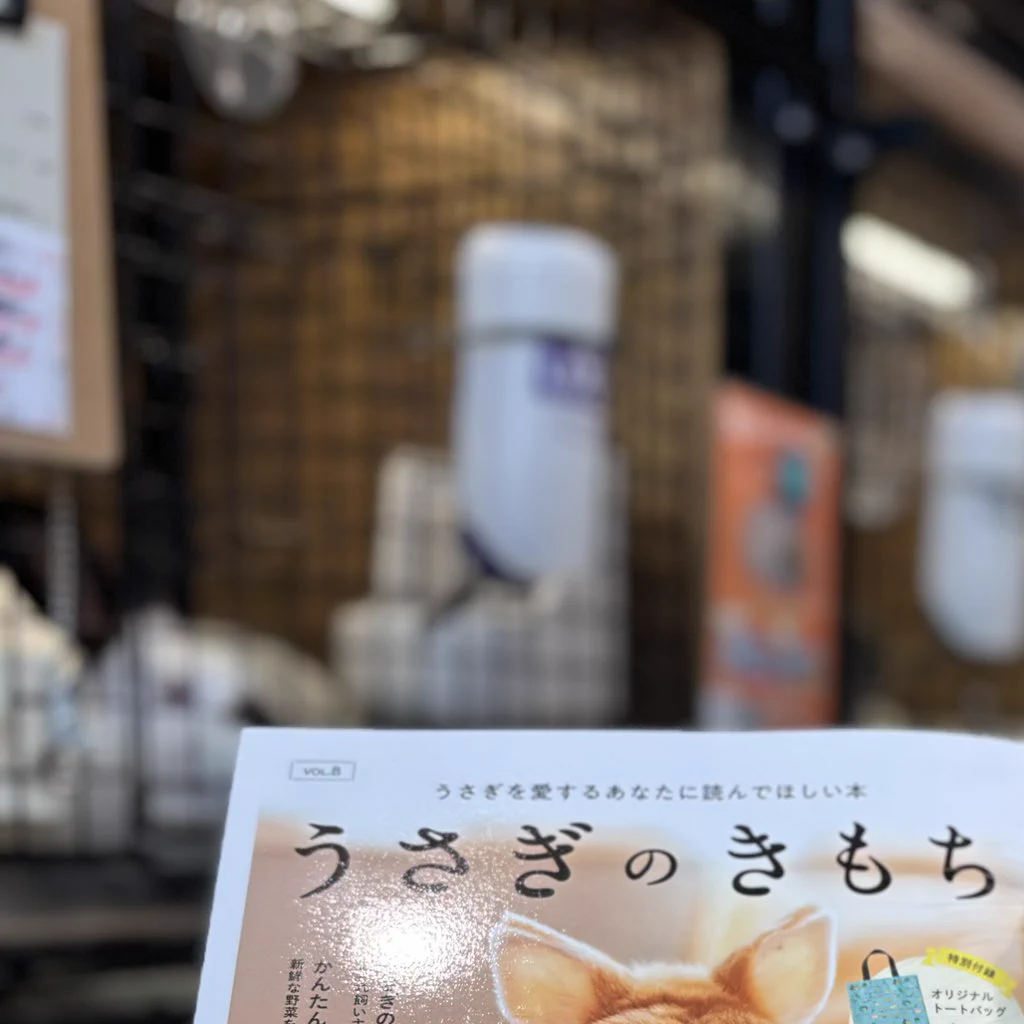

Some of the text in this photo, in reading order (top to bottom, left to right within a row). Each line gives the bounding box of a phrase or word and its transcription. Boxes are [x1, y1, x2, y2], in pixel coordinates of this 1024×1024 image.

[435, 781, 867, 802] うさぎを愛するあなたに読んでほしい本
[294, 821, 997, 900] うさぎのきもち
[931, 989, 995, 1002] オリジナル
[933, 1003, 1008, 1018] トートバッグ
